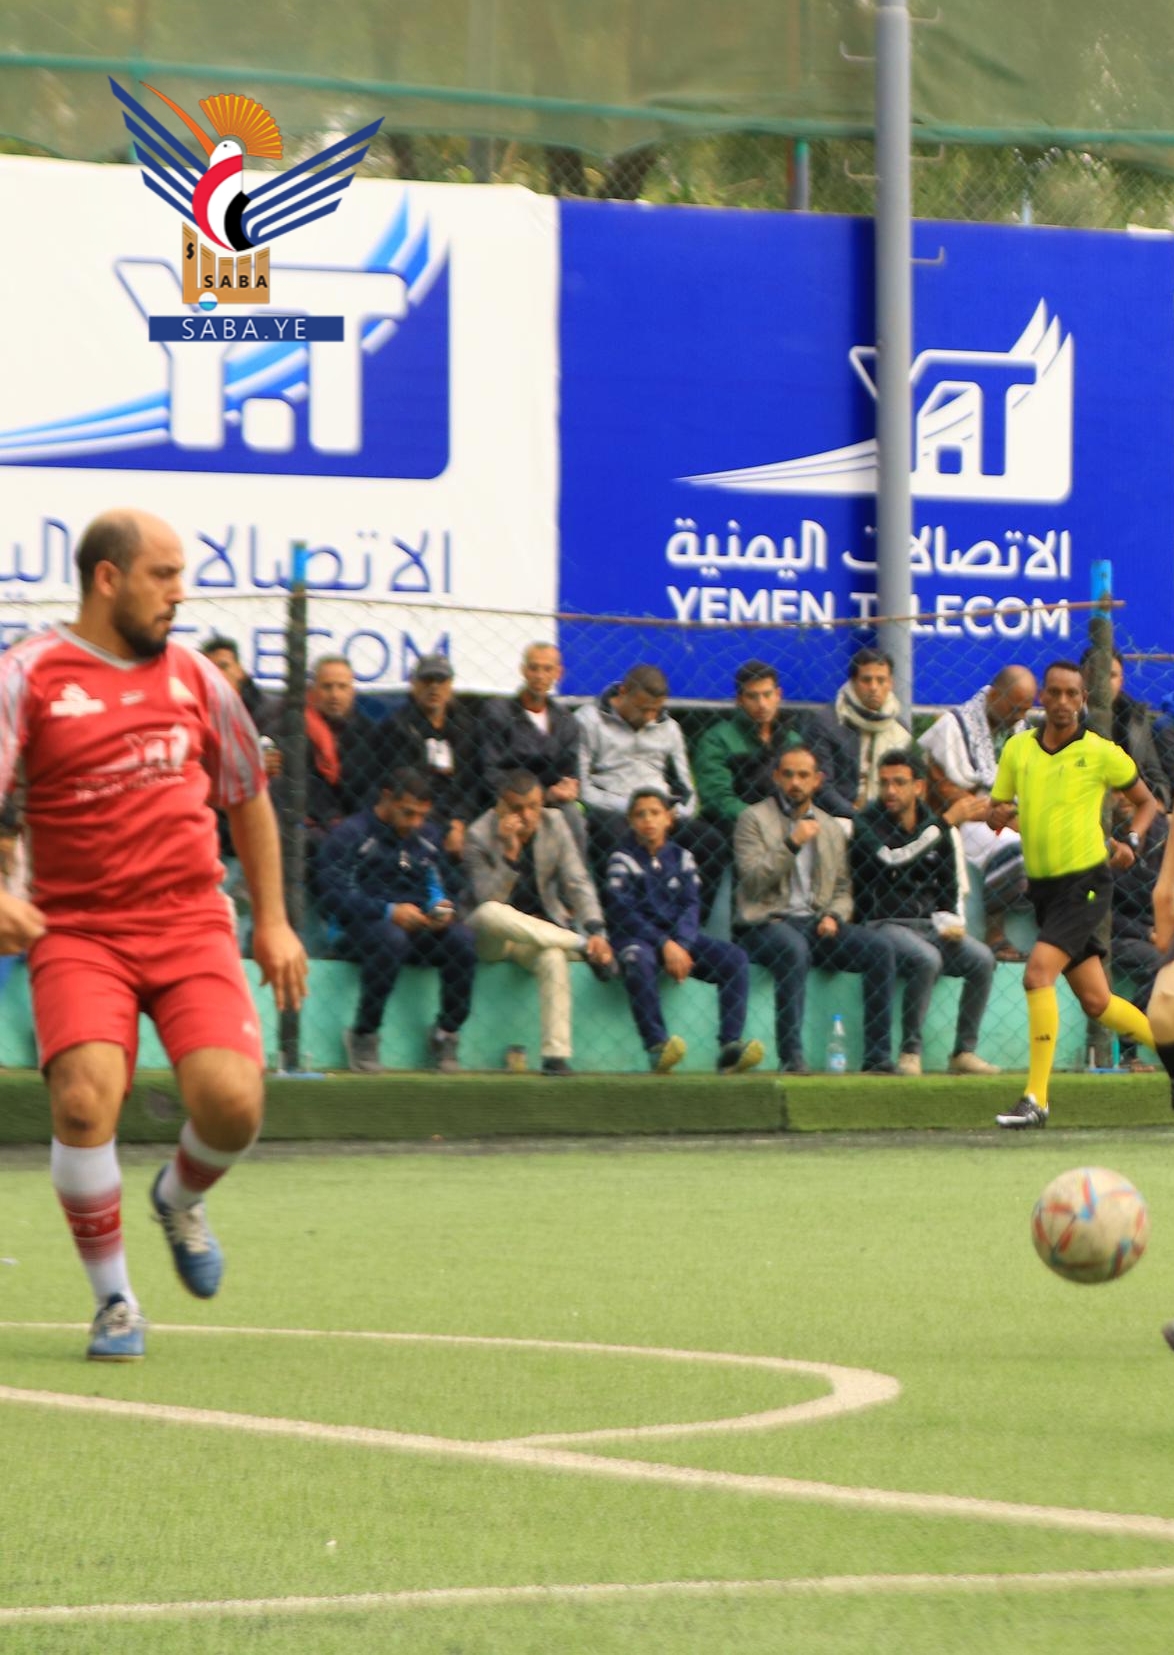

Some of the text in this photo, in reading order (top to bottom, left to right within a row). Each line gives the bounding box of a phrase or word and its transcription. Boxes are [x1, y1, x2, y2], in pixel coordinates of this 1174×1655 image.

[667, 517, 827, 578] اليمنية
[667, 585, 1070, 638] YEMEN TLECOM
